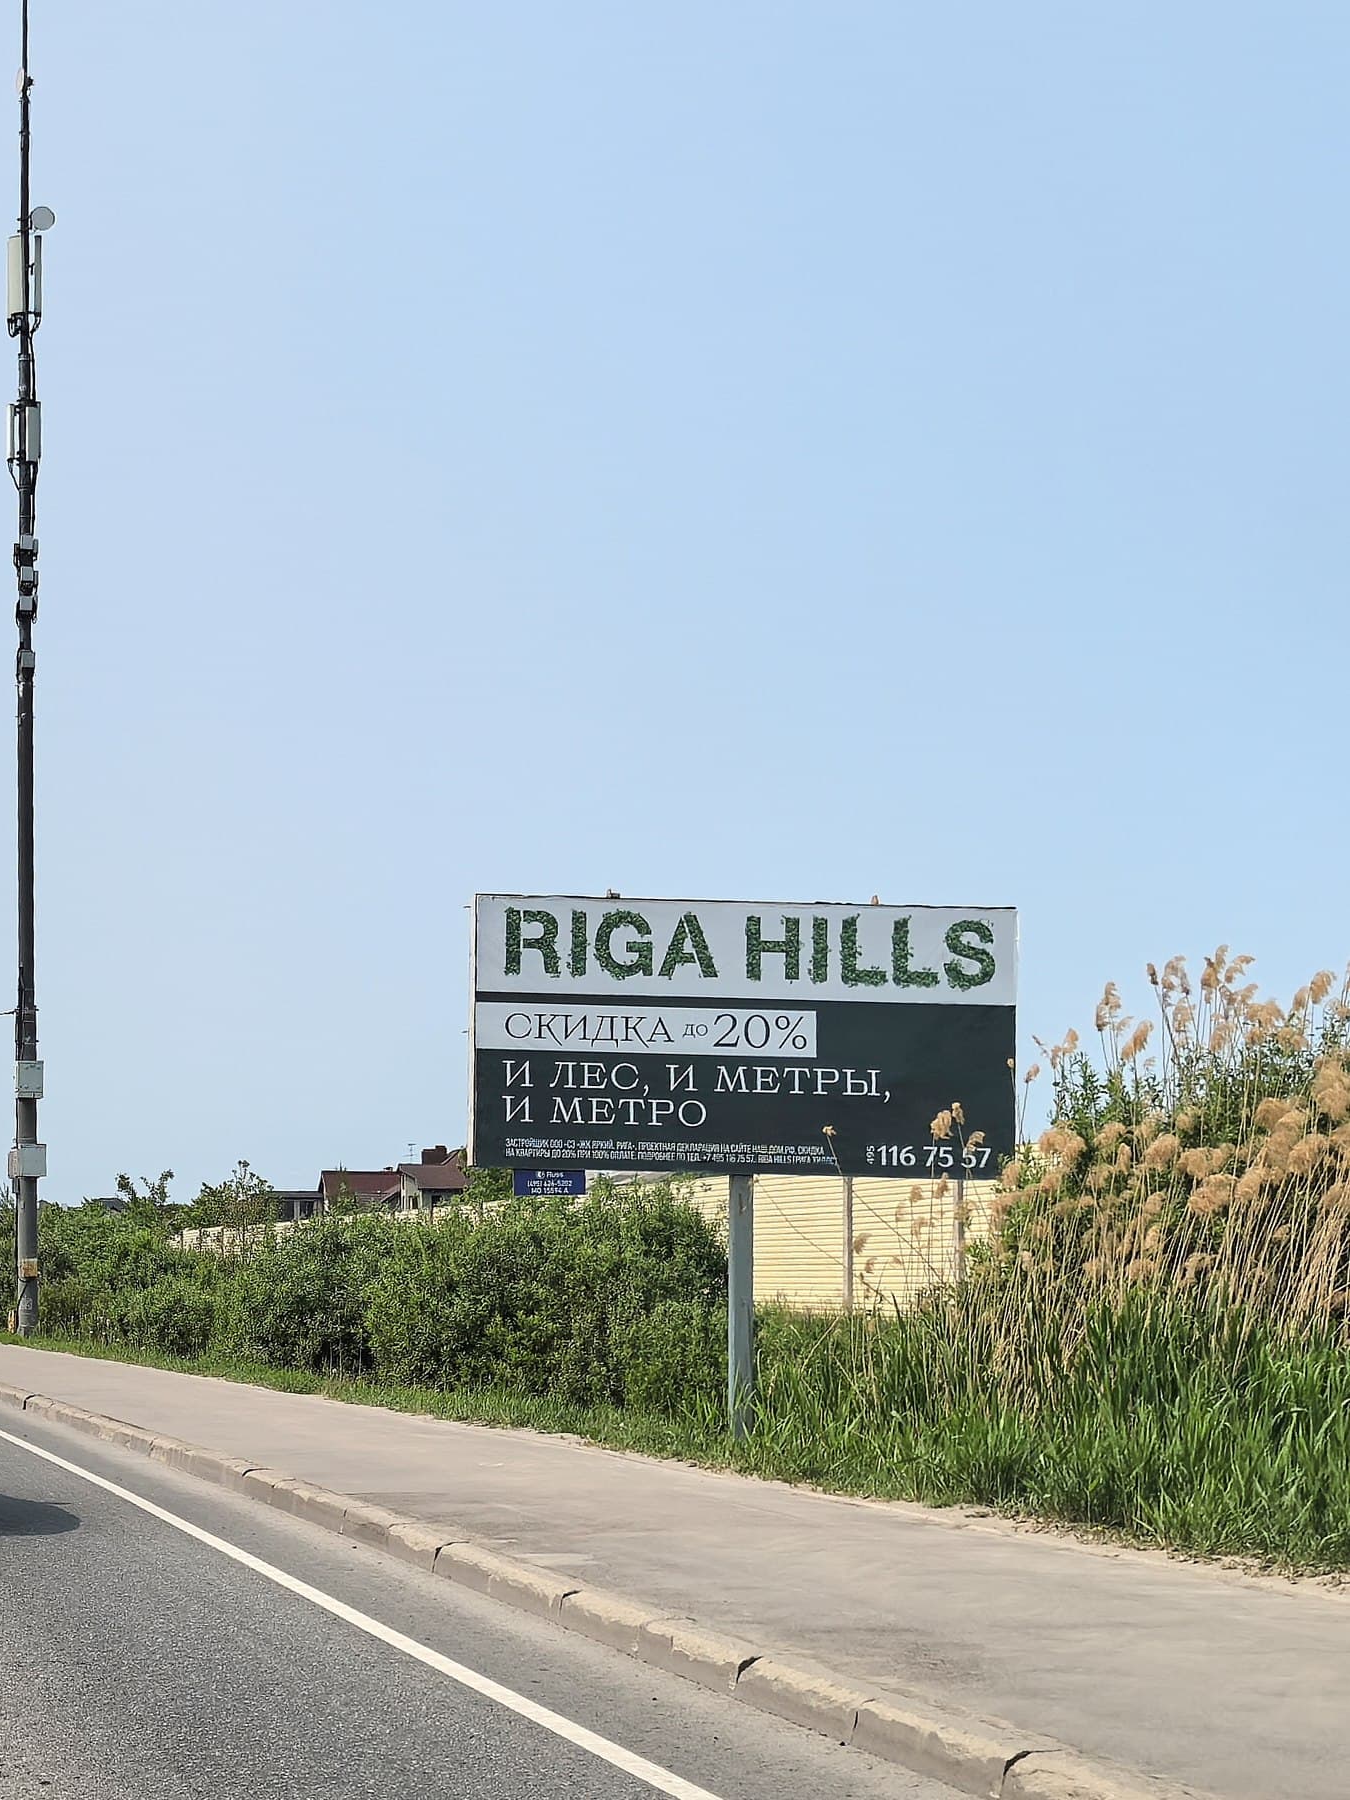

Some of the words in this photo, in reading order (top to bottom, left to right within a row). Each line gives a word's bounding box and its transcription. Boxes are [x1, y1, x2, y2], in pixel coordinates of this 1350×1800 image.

[504, 907, 719, 981] RIGA
[745, 913, 996, 991] HILLS
[505, 1012, 675, 1049] СКИДКА
[713, 1013, 808, 1051] 20%
[502, 1060, 534, 1088] И
[549, 1061, 650, 1097] ЛЕС,
[666, 1064, 699, 1092] И
[714, 1065, 891, 1104] МЕТРЫ,
[502, 1096, 534, 1124] И
[549, 1097, 707, 1128] МЕТРО
[866, 1145, 875, 1165] 495
[876, 1145, 917, 1167] 116
[922, 1146, 955, 1168] 75
[960, 1147, 992, 1169] 57
